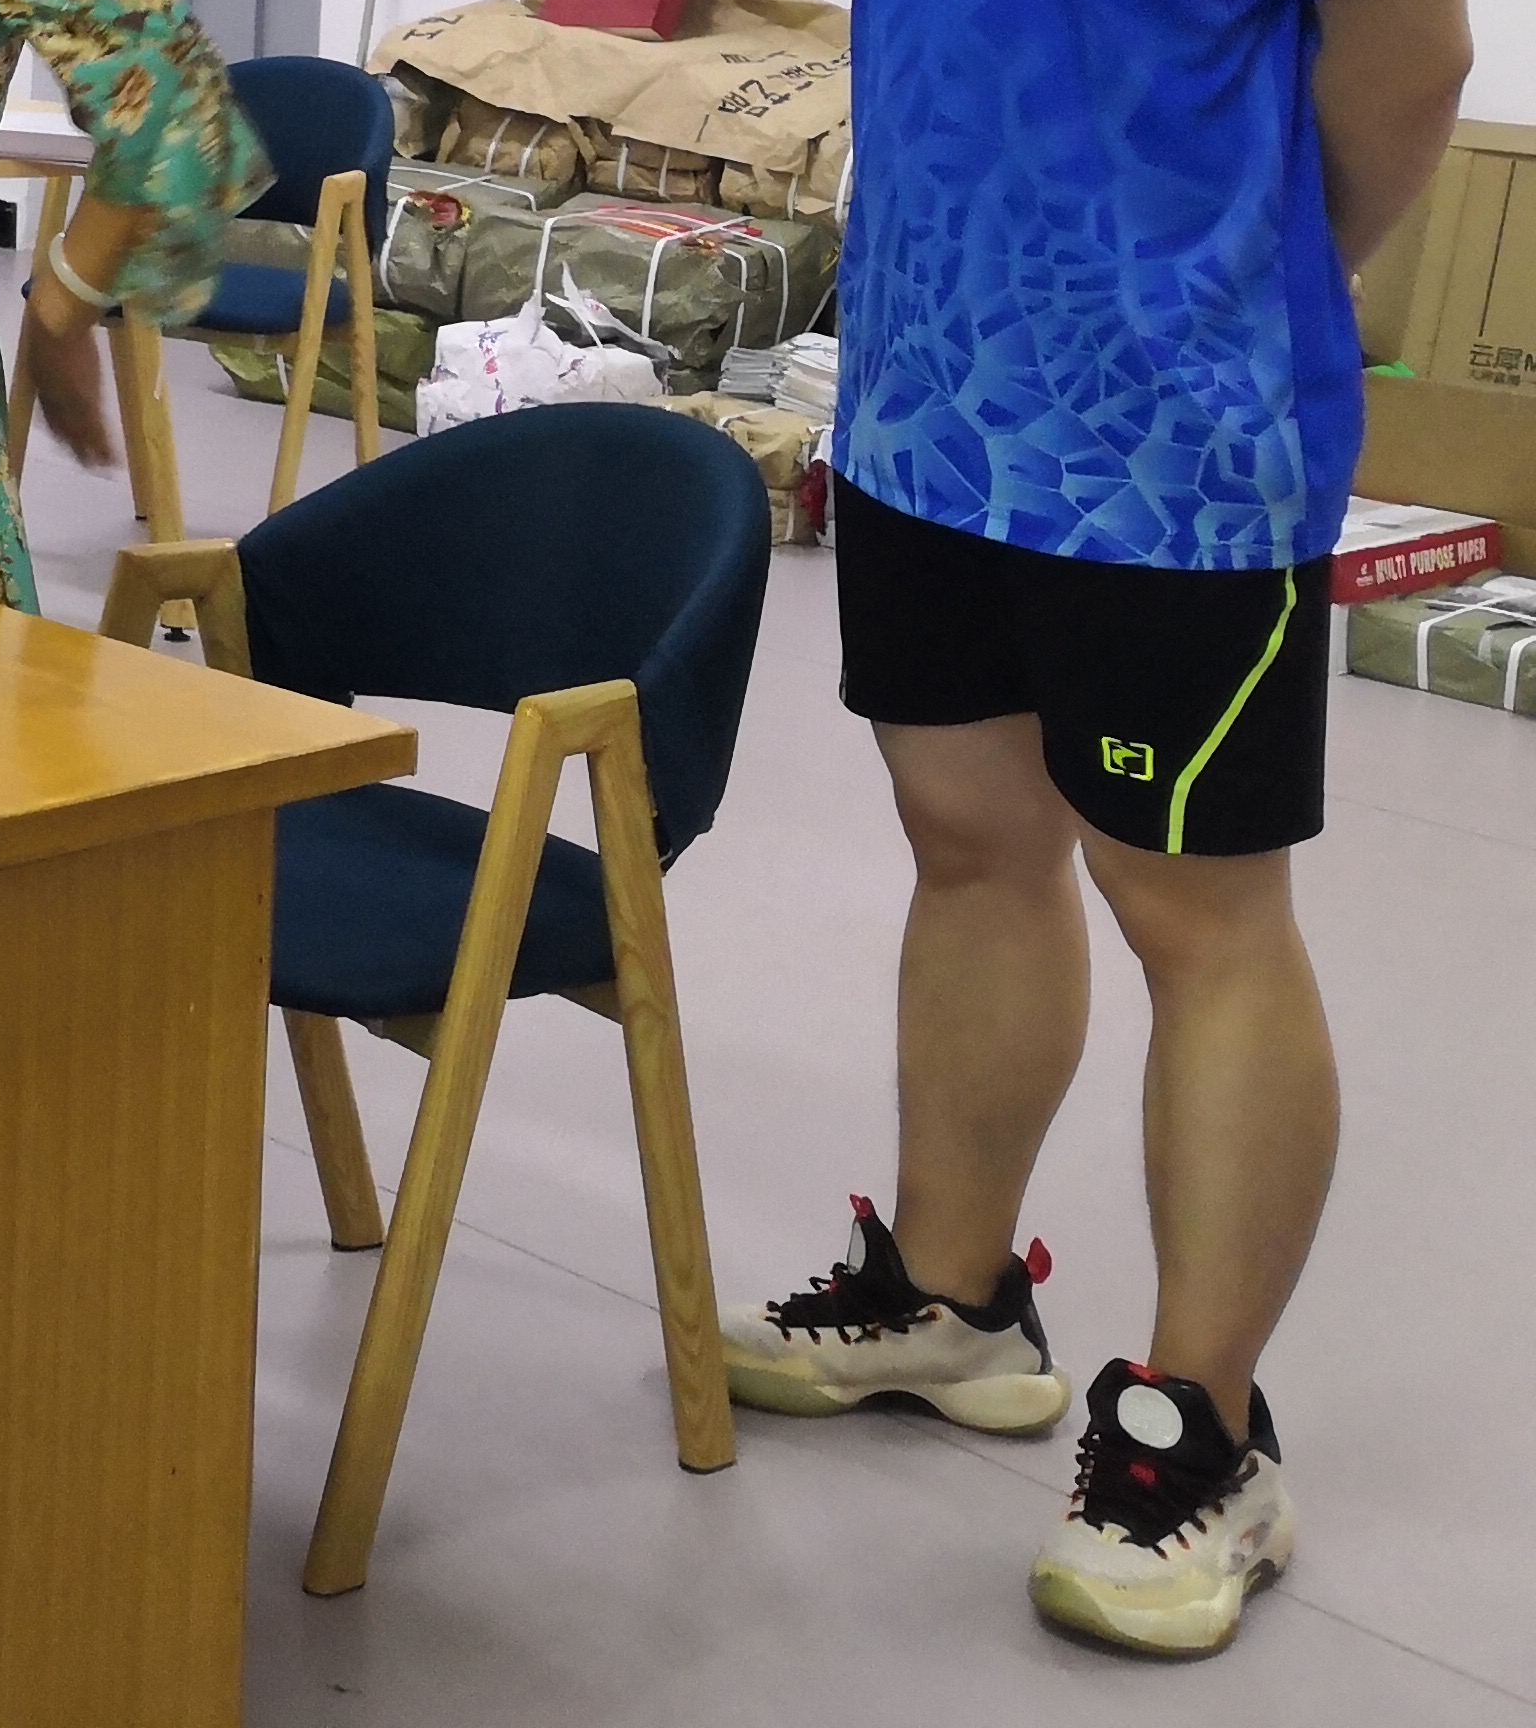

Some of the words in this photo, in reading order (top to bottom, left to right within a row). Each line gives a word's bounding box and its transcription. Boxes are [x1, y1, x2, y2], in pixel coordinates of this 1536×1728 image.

[1375, 554, 1407, 585] MULTI
[1409, 543, 1457, 576] PURPOSE
[1457, 536, 1487, 566] PAPER
